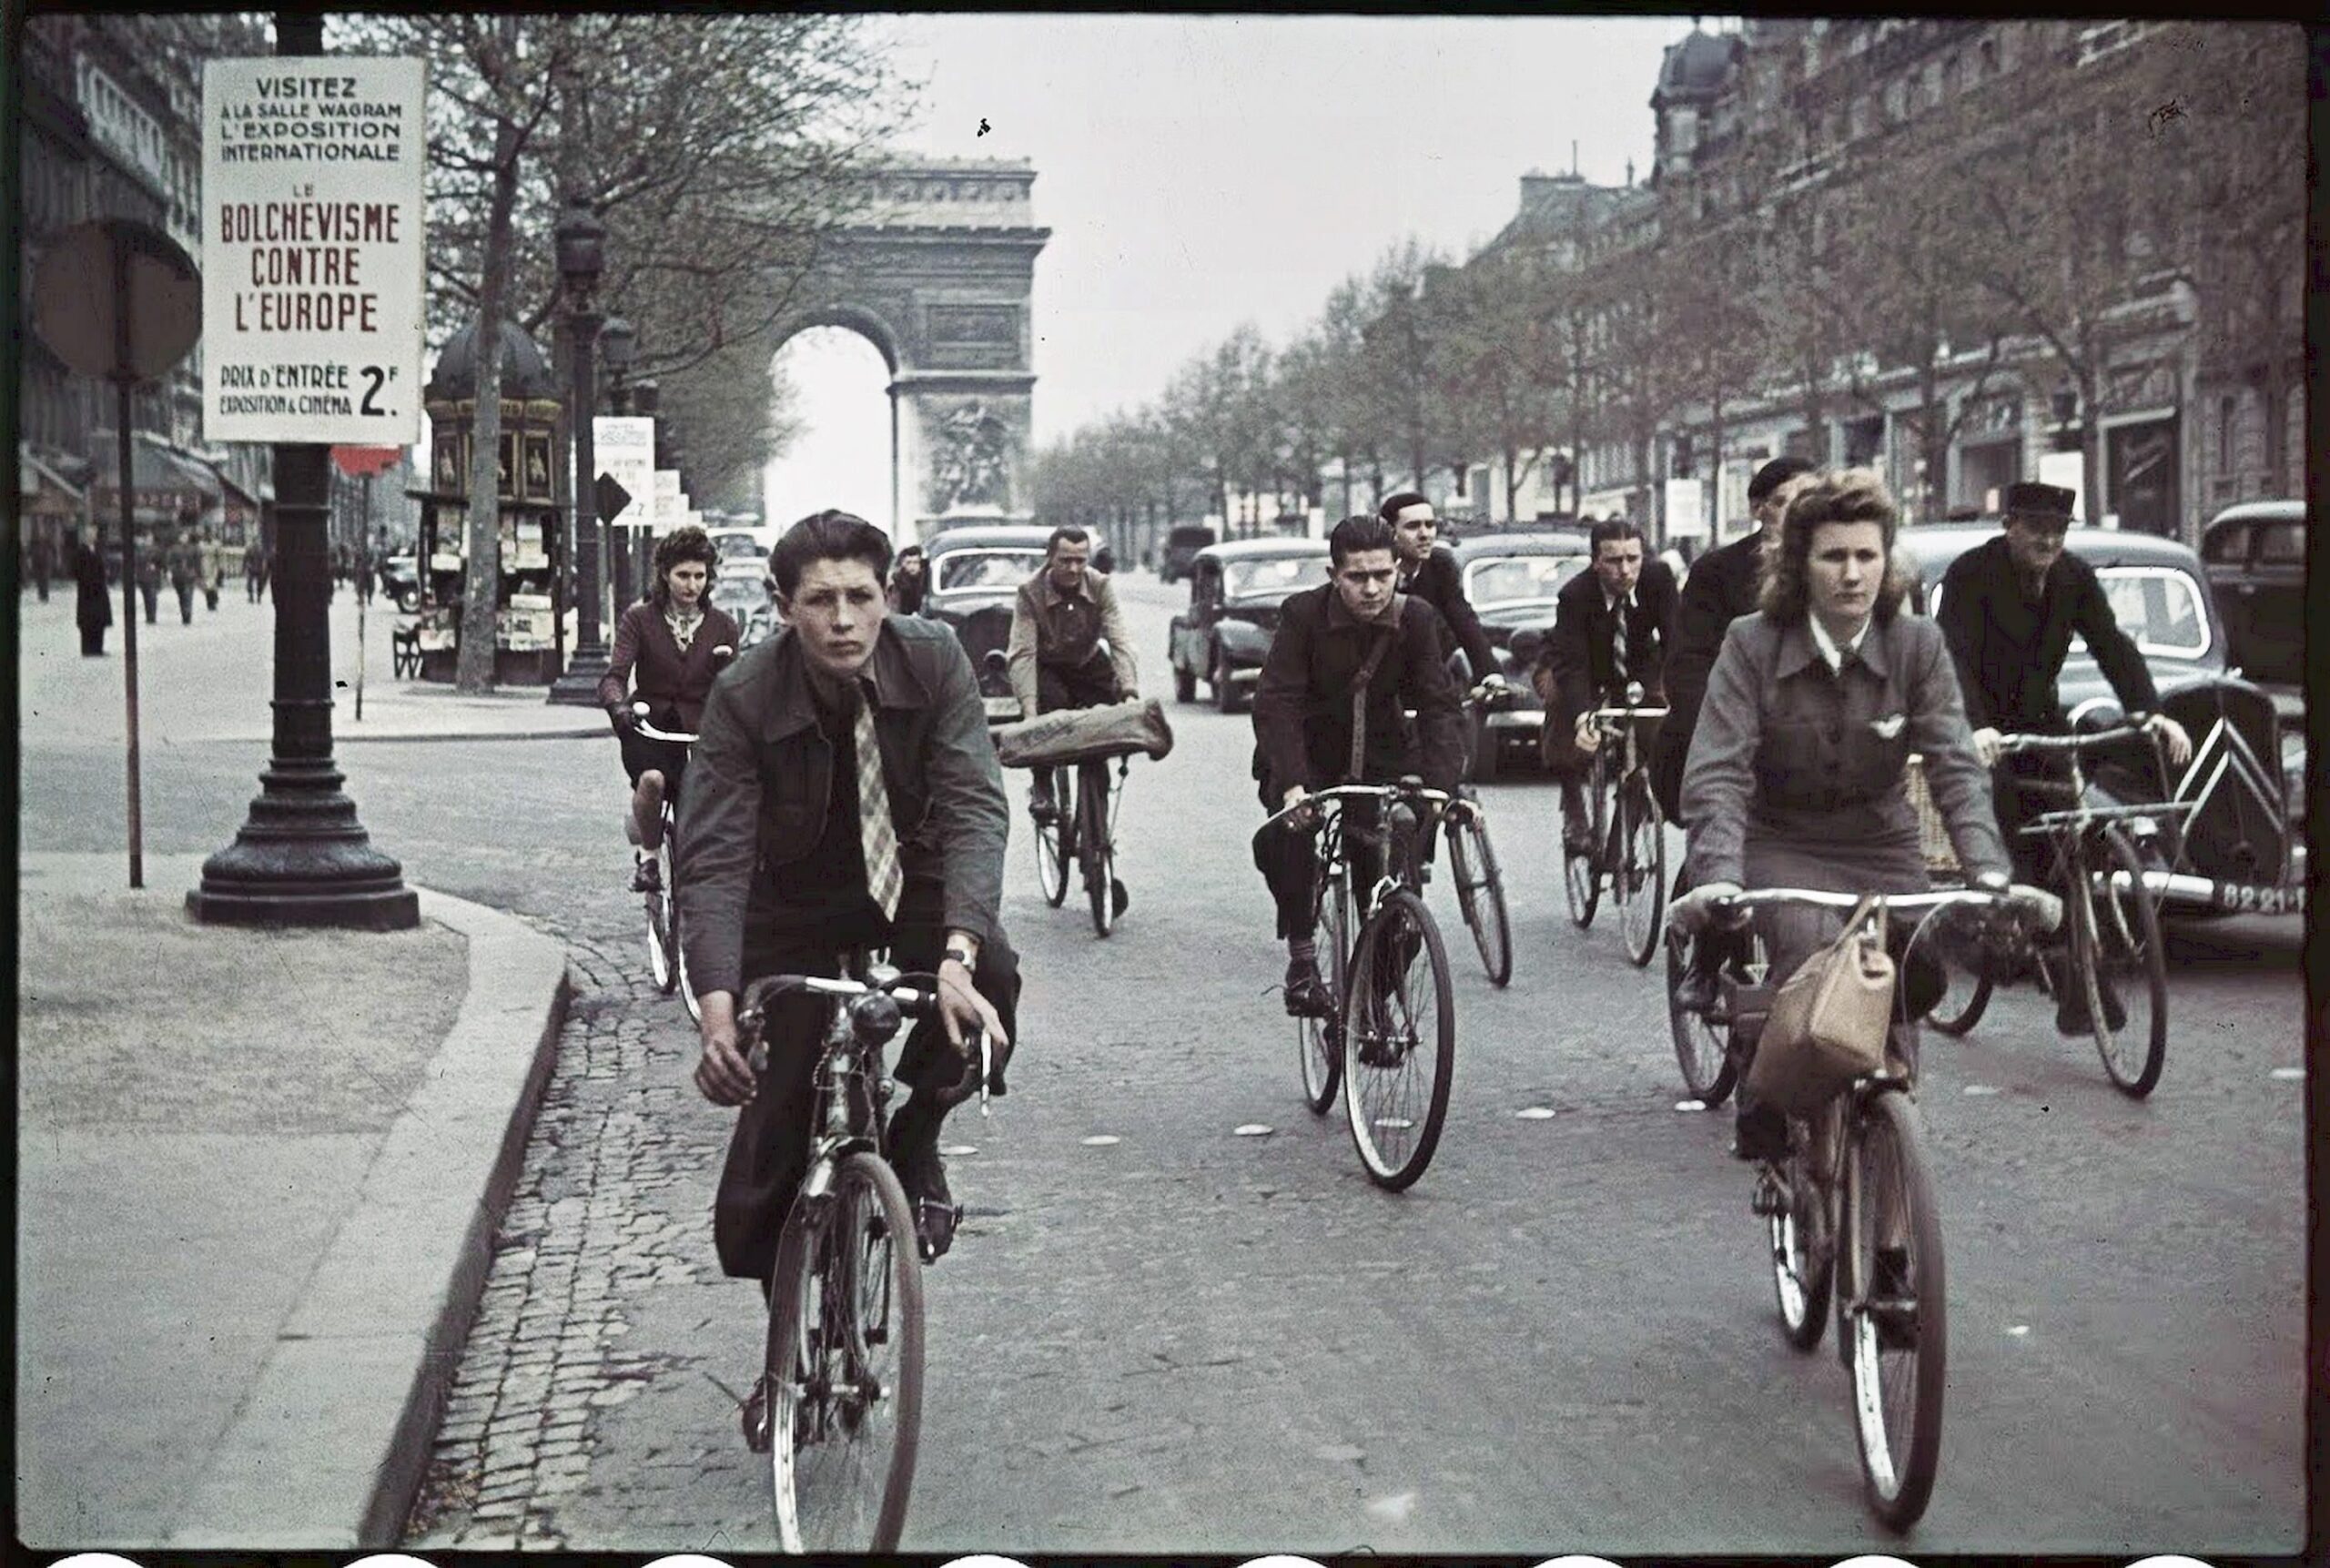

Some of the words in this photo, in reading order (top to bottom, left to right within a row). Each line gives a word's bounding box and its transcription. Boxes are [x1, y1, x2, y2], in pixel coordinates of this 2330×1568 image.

[256, 76, 357, 98] VISITEZ
[233, 103, 253, 119] LA
[257, 103, 310, 119] SALLE
[319, 103, 402, 119] WAGRAM
[221, 121, 400, 140] L'EXPOSITION
[221, 142, 400, 163] INTERNATIONALE
[293, 185, 314, 198] LE
[221, 202, 400, 244] BOLCHEVISME
[252, 247, 360, 288] CONTRE
[236, 292, 378, 333] L'EUROPE
[221, 364, 255, 389] PRIX
[220, 394, 286, 415] EXPOSITION
